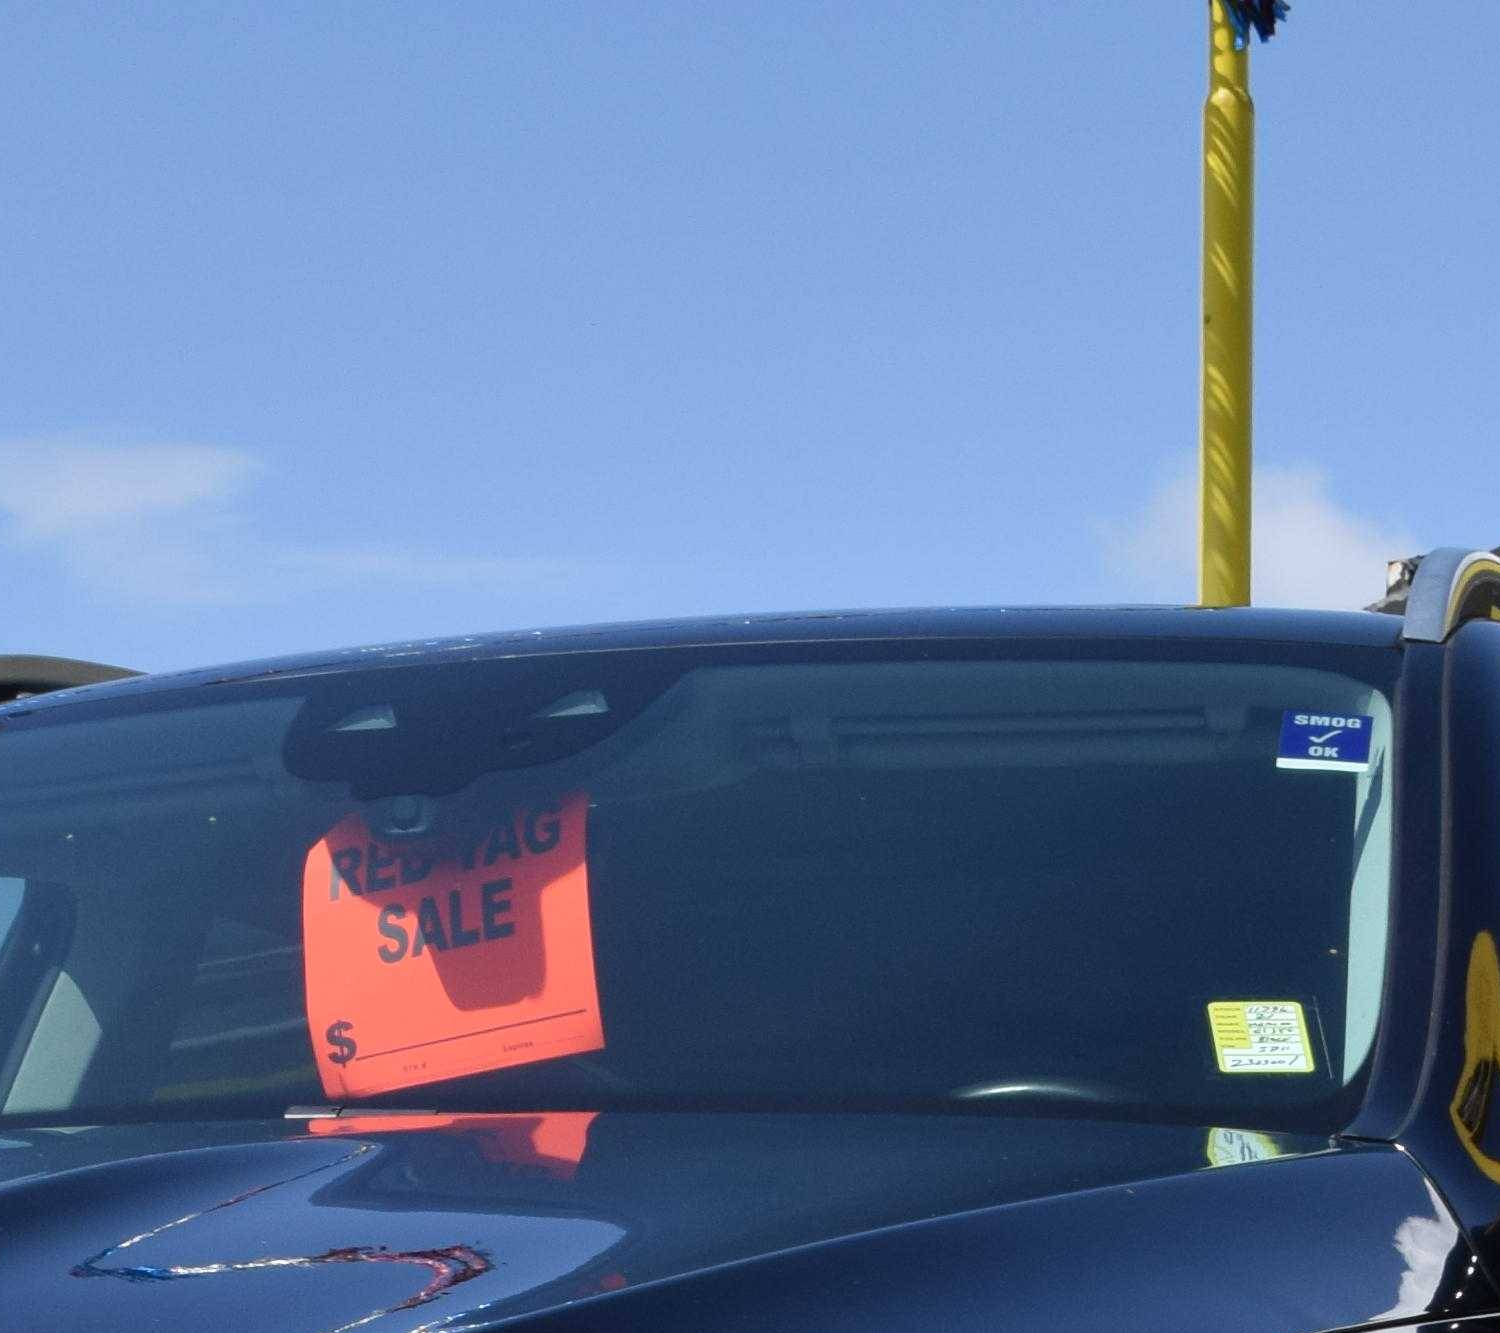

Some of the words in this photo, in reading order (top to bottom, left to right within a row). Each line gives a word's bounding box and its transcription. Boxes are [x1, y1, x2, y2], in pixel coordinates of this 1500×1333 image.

[1293, 714, 1362, 729] SMOG
[1307, 745, 1339, 758] OK
[376, 876, 516, 965] SALE
[324, 1019, 358, 1069] $
